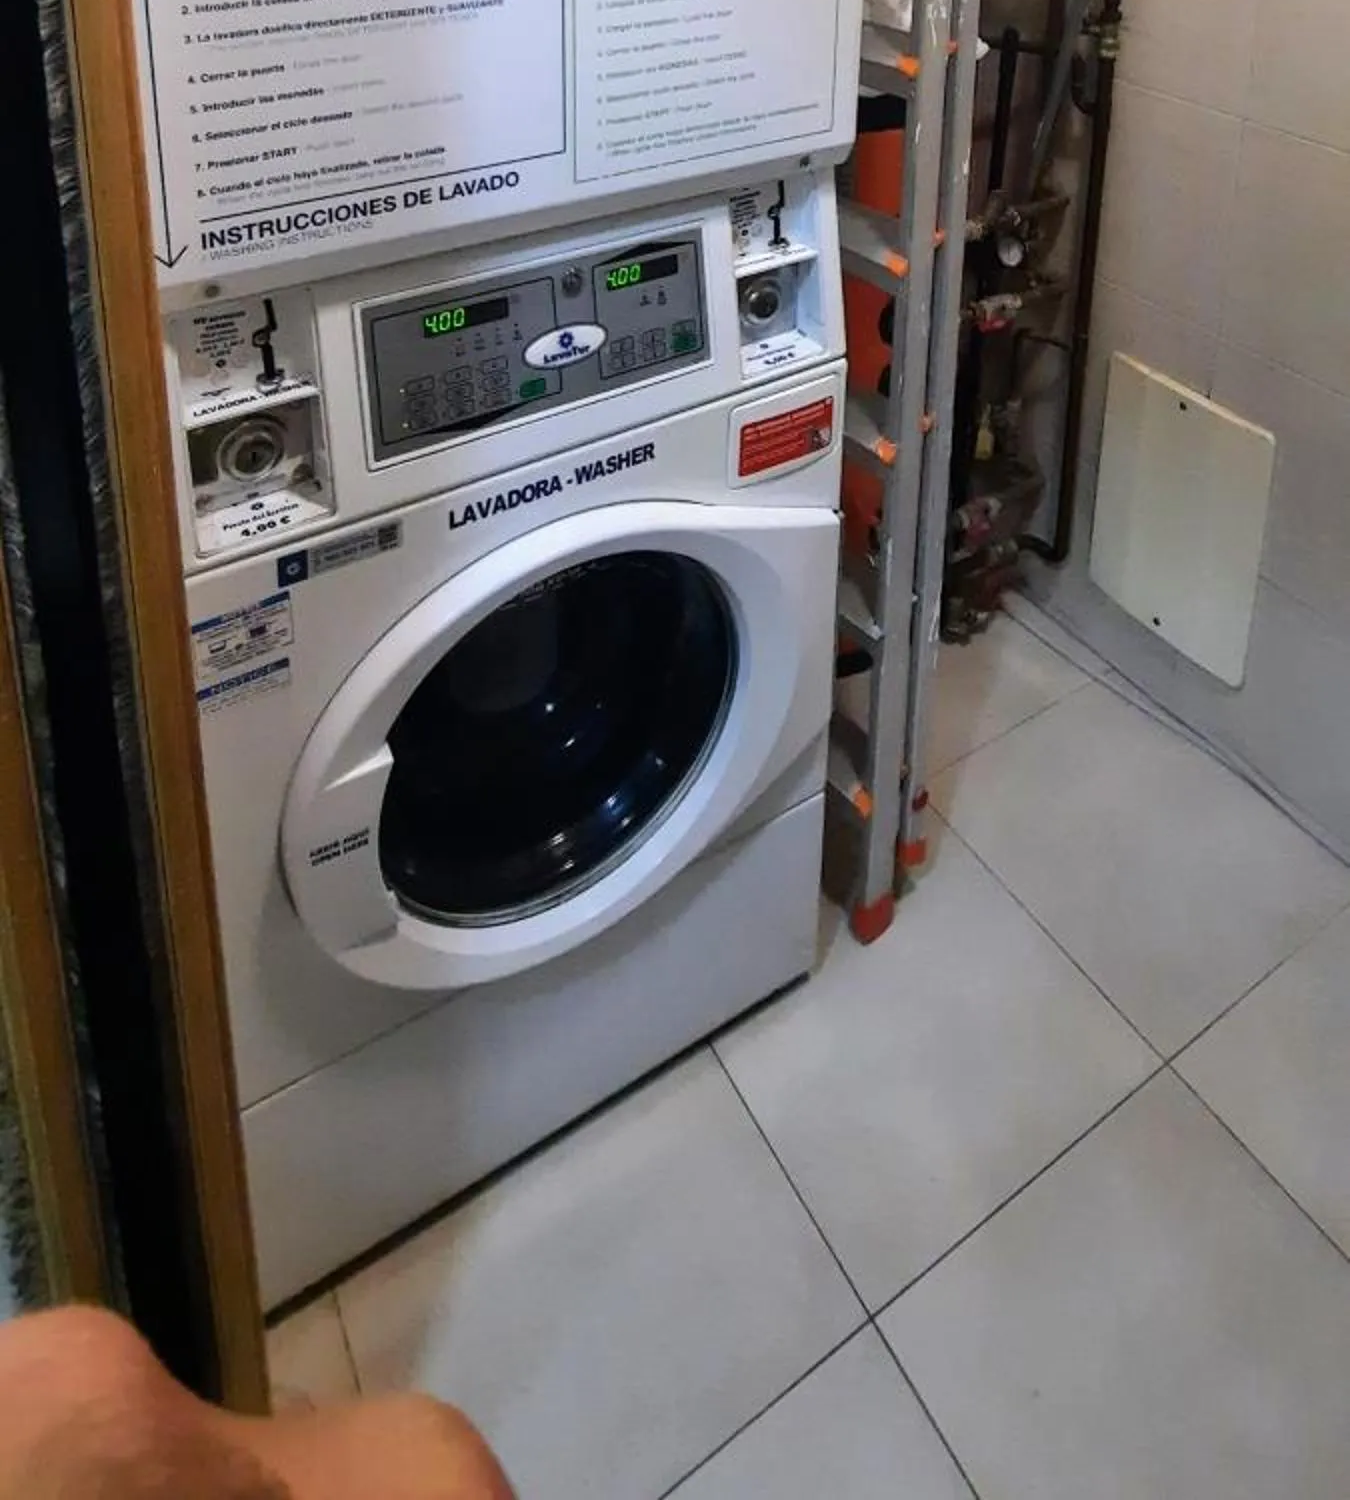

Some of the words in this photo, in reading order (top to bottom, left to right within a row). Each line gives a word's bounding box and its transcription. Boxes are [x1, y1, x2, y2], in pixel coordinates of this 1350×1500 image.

[262, 146, 298, 161] START
[201, 195, 397, 250] INSTRUCCIONES
[403, 188, 433, 209] DE
[439, 171, 520, 201] LAVADO
[193, 395, 258, 418] LAVADORA
[449, 474, 563, 531] LAVADORA
[574, 442, 656, 485] WASHER
